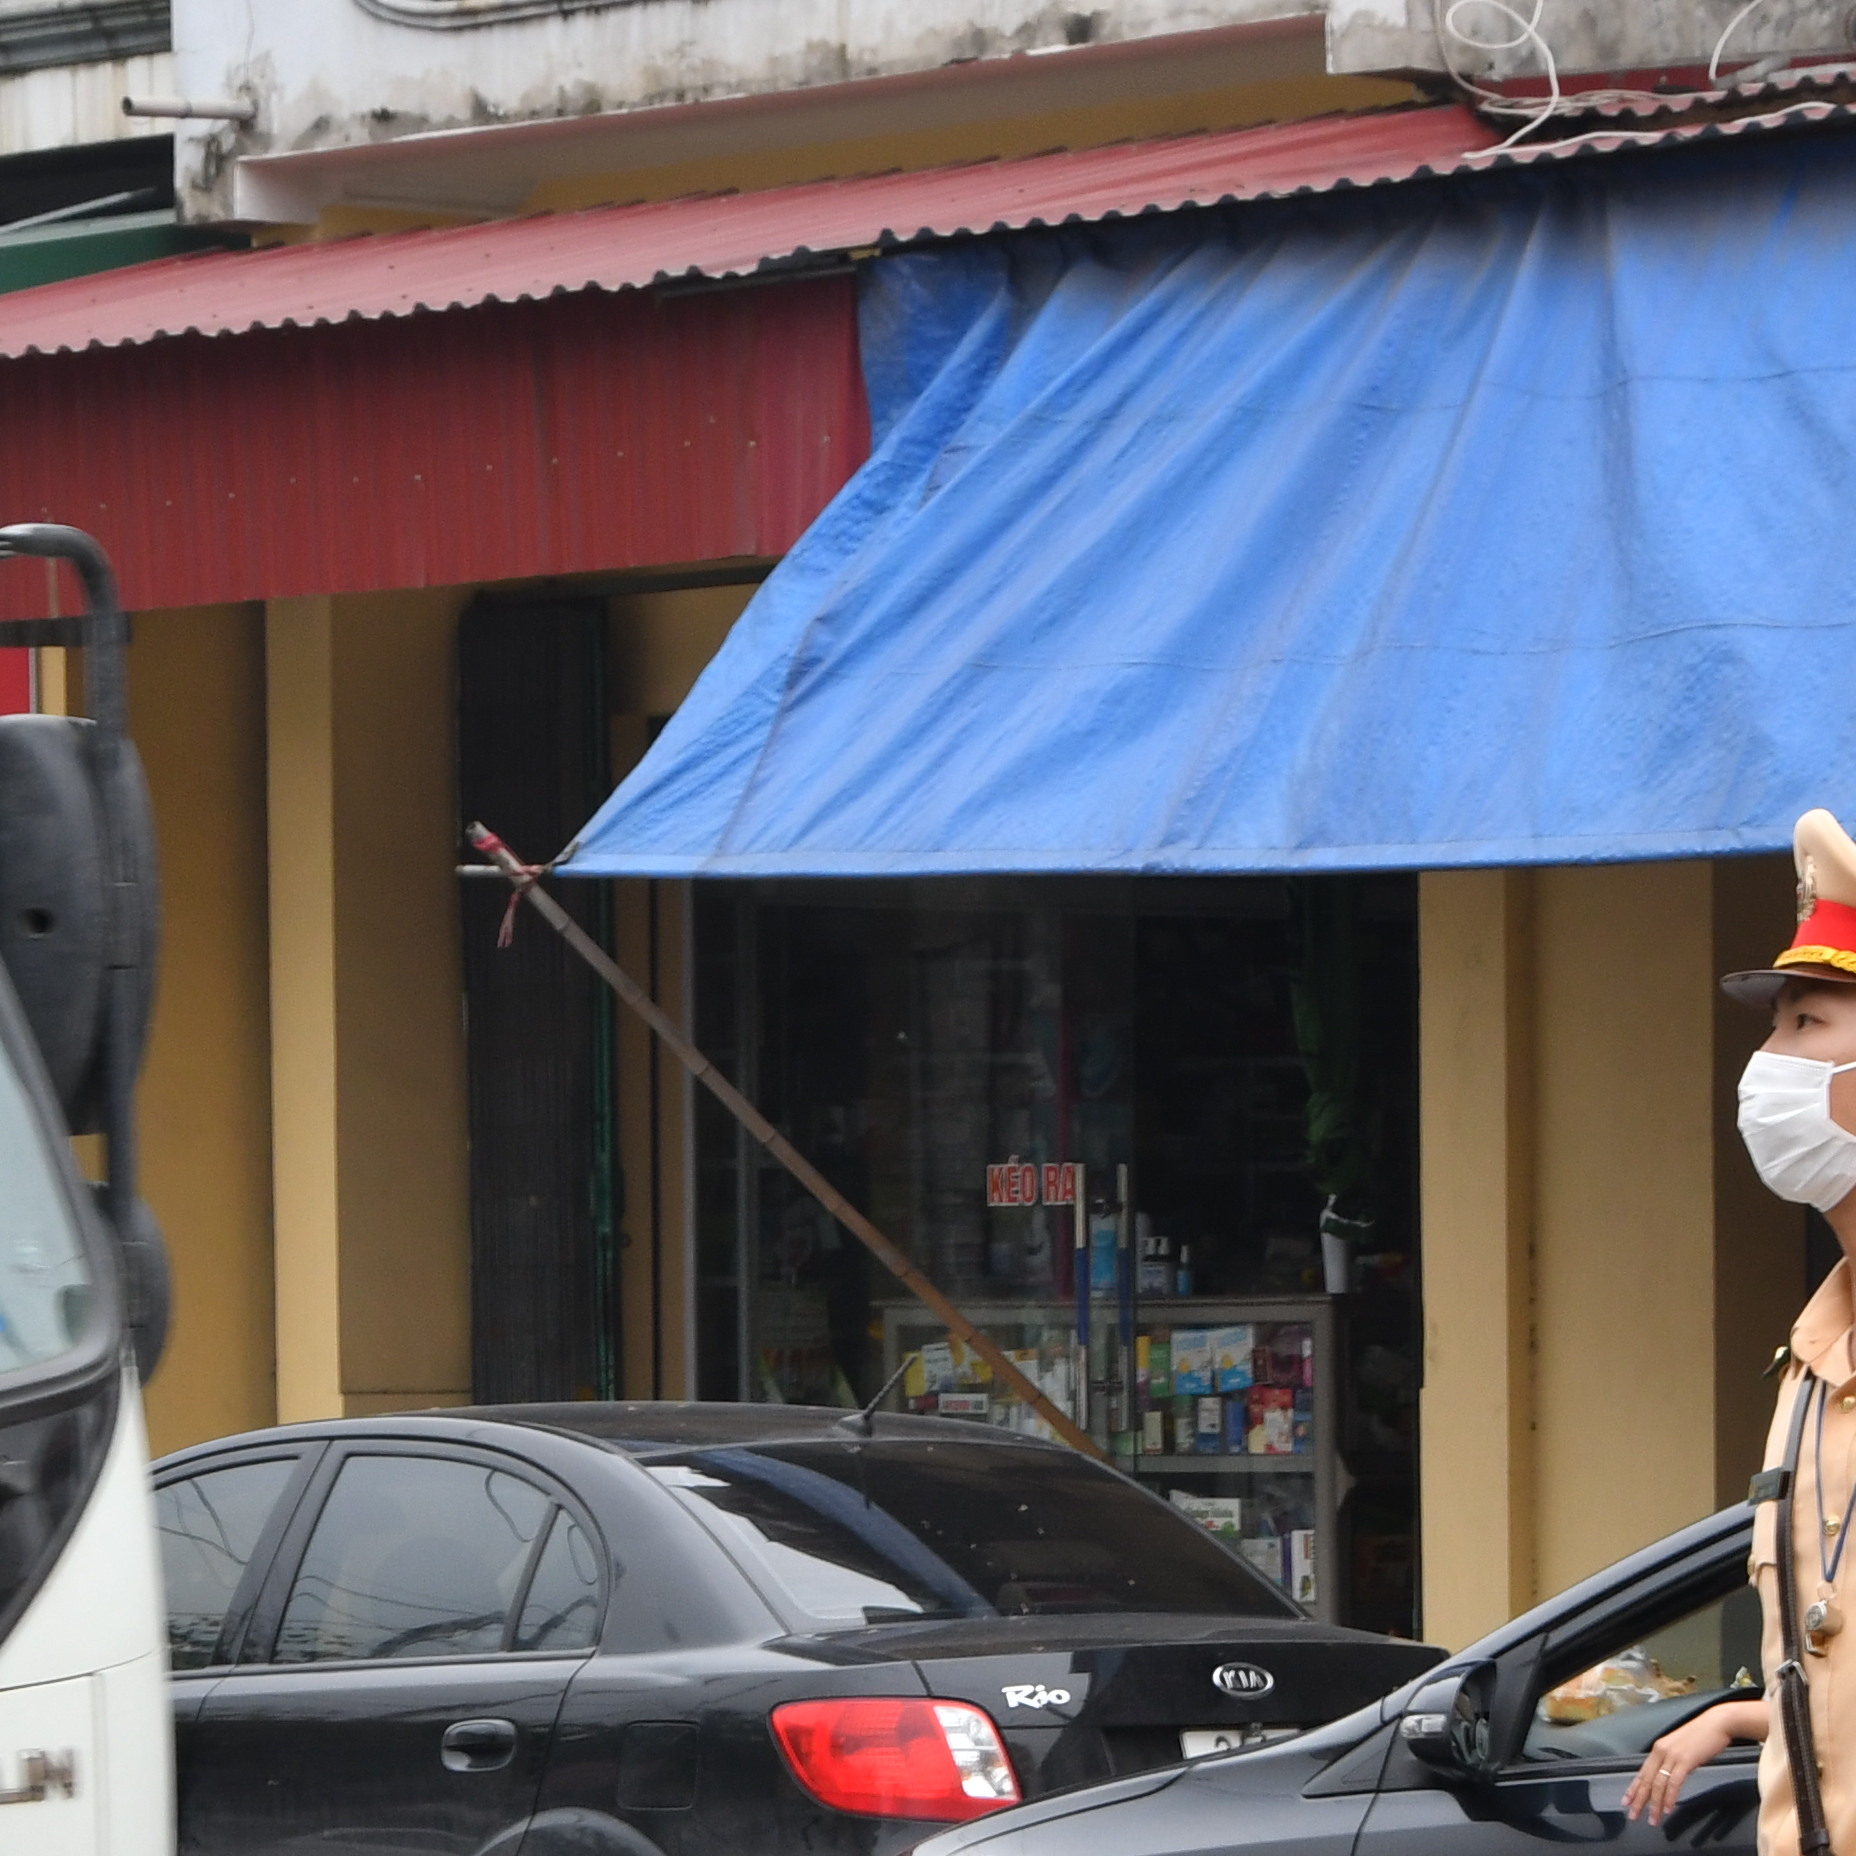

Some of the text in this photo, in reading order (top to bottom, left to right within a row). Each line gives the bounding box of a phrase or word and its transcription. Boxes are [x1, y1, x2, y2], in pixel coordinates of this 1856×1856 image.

[986, 1155, 1077, 1206] KÉO RA
[1001, 1684, 1072, 1709] Rio
